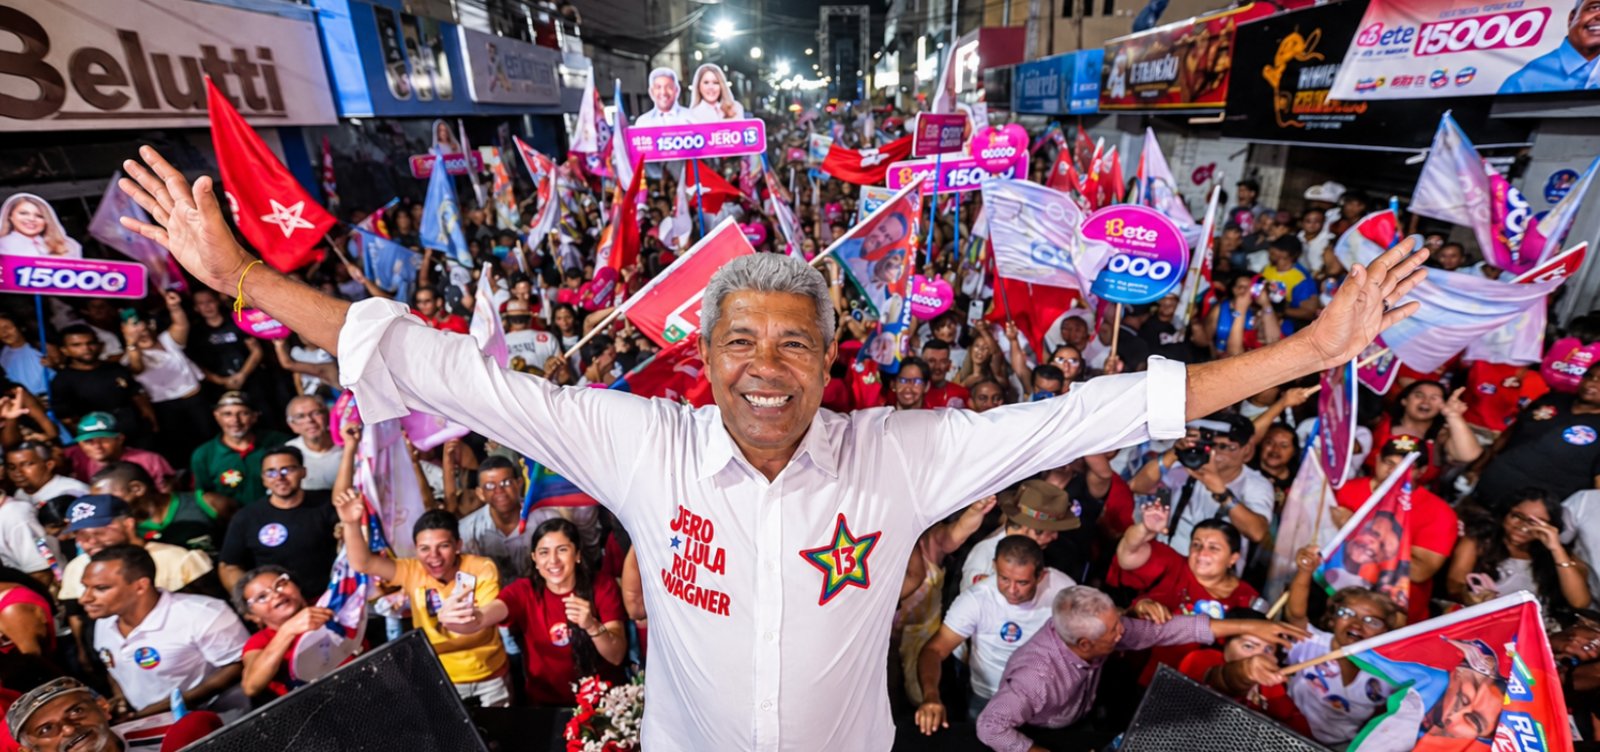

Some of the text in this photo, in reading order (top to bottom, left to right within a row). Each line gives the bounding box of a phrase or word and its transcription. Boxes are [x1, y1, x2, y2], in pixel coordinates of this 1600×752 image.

[1417, 10, 1546, 54] 15000
[657, 135, 704, 151] 15000
[708, 131, 742, 146] JERO
[1106, 217, 1158, 242] Bete
[17, 266, 126, 291] 15000
[1108, 254, 1172, 280] 000
[670, 504, 714, 544] JERO
[671, 552, 697, 584] RUI
[684, 536, 726, 575] LULA
[831, 546, 857, 576] 13
[661, 568, 731, 617] WAGNER
